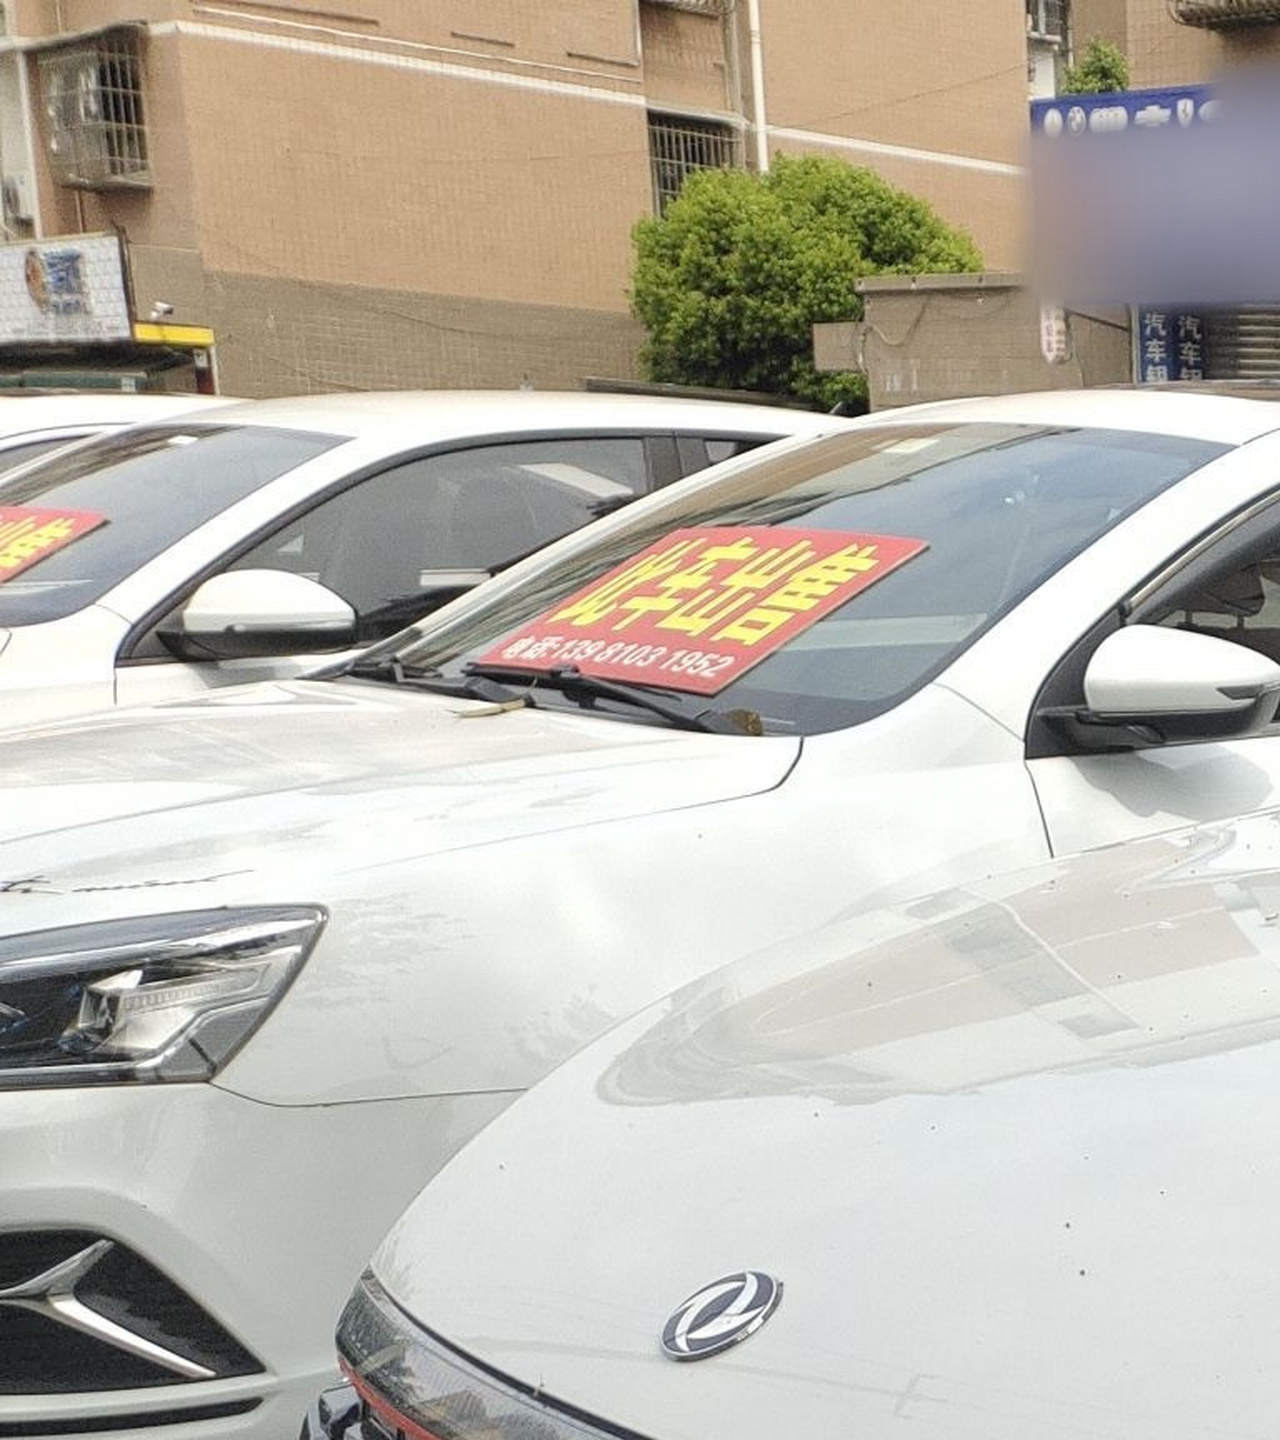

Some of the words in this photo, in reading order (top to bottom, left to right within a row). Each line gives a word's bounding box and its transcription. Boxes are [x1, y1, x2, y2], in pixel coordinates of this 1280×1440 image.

[546, 537, 880, 646] 此车出售
[660, 650, 735, 678] 1952
